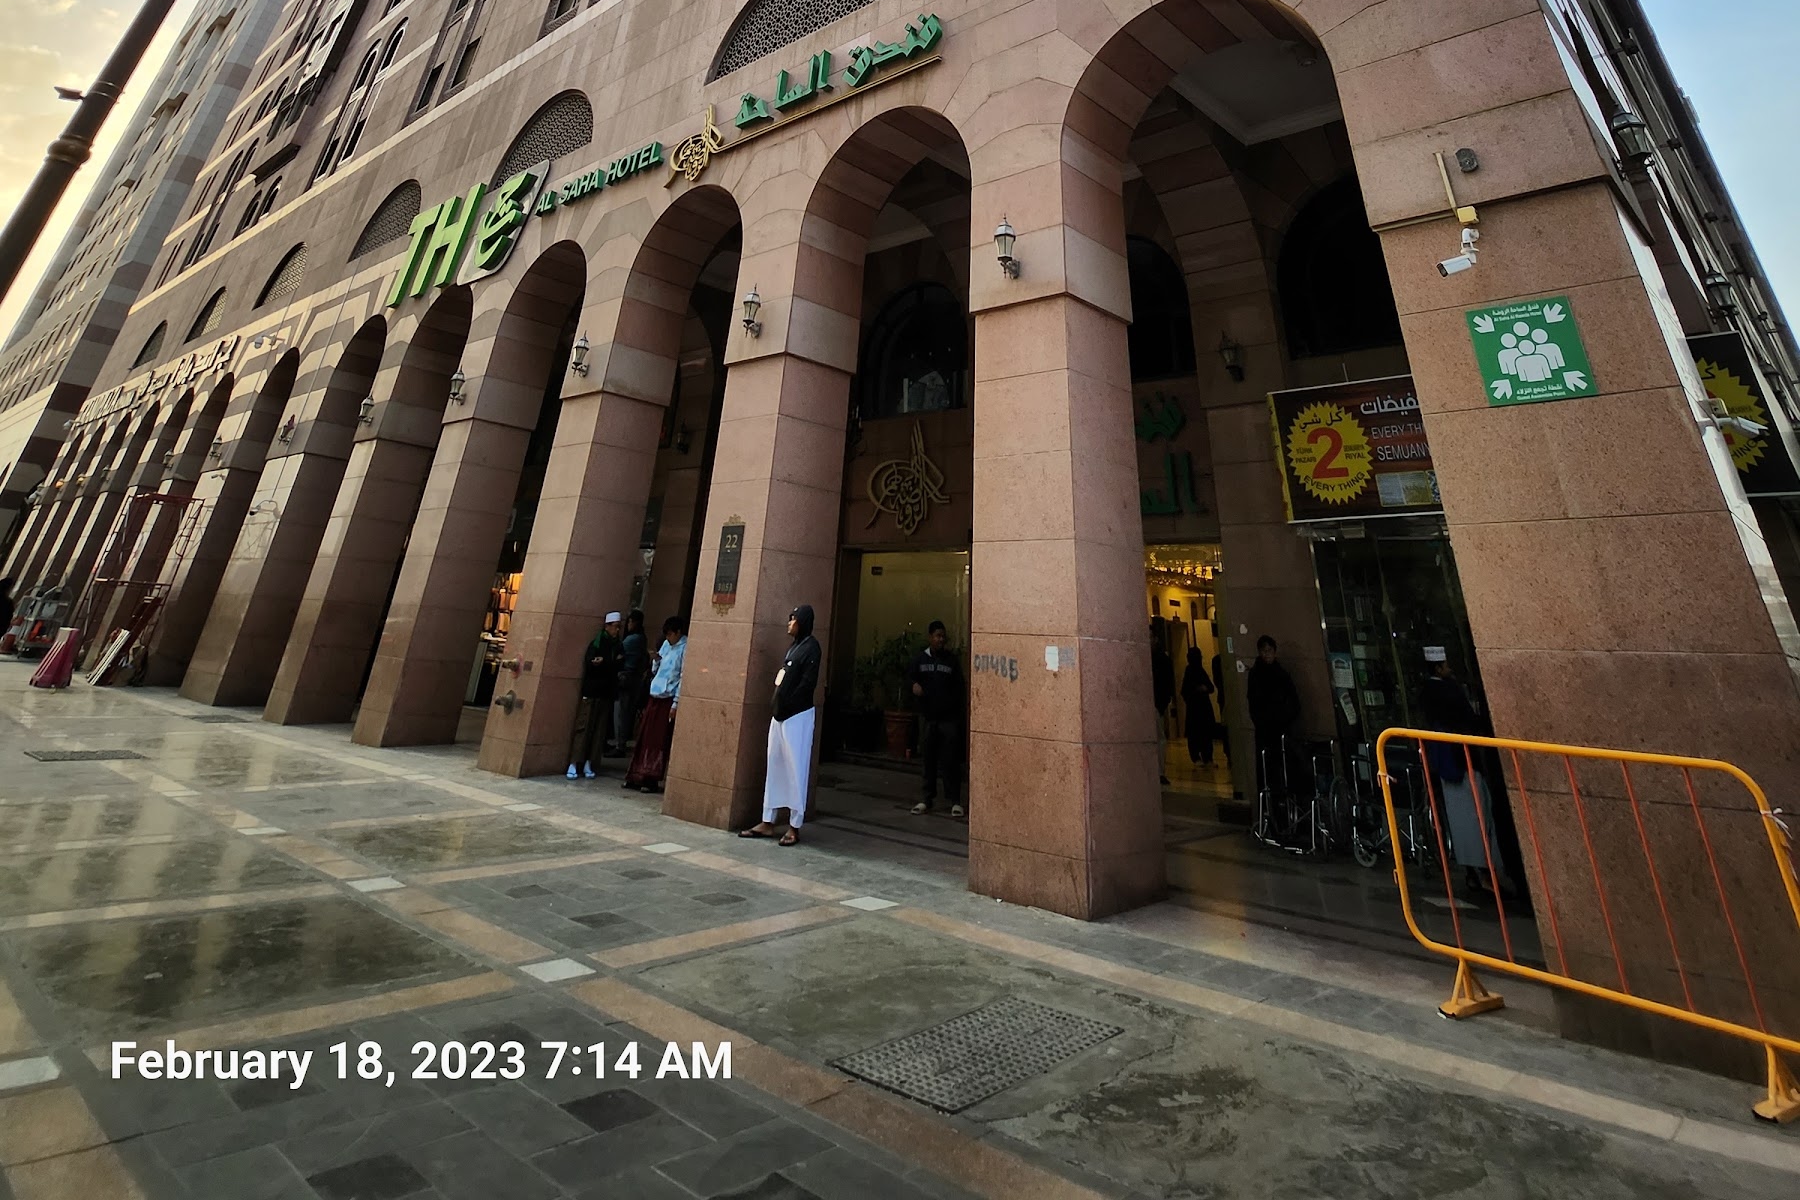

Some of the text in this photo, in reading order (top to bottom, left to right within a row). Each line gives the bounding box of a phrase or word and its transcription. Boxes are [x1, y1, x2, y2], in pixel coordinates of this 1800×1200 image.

[842, 13, 943, 88] فندق
[534, 141, 664, 217] AL SAHA HOTEL
[1325, 410, 1344, 427] كل
[1371, 424, 1405, 440] EVERY
[1307, 427, 1349, 480] 2
[1344, 452, 1367, 460] RIYAL
[1303, 471, 1366, 492] EVERY THING
[725, 534, 738, 549] 22
